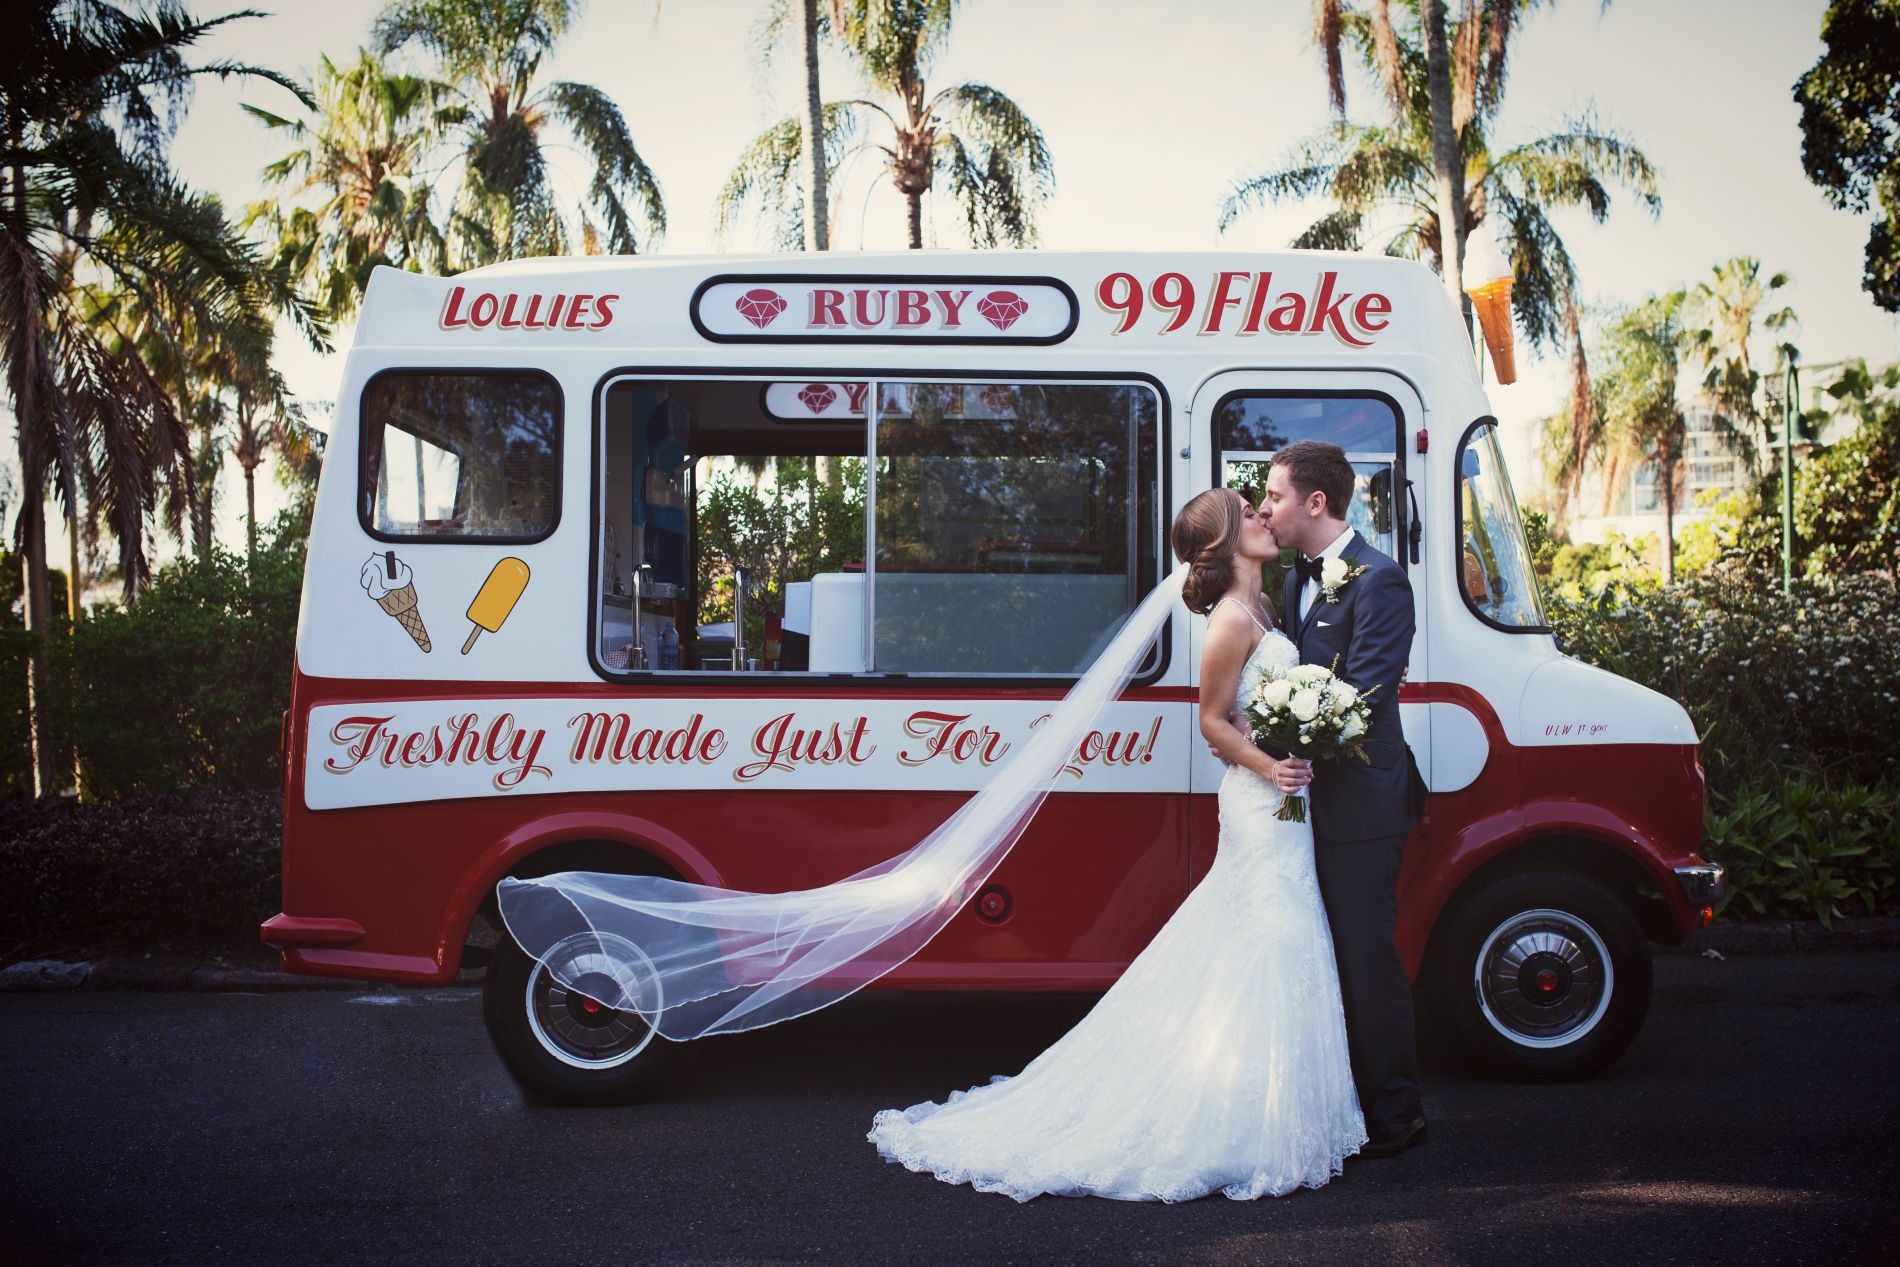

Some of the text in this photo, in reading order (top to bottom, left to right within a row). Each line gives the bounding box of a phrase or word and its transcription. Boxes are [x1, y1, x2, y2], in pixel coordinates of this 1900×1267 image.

[439, 286, 619, 331] LOLLIES
[806, 289, 973, 331] RUBY
[323, 711, 1164, 791] Freshly Made Just For ou!
